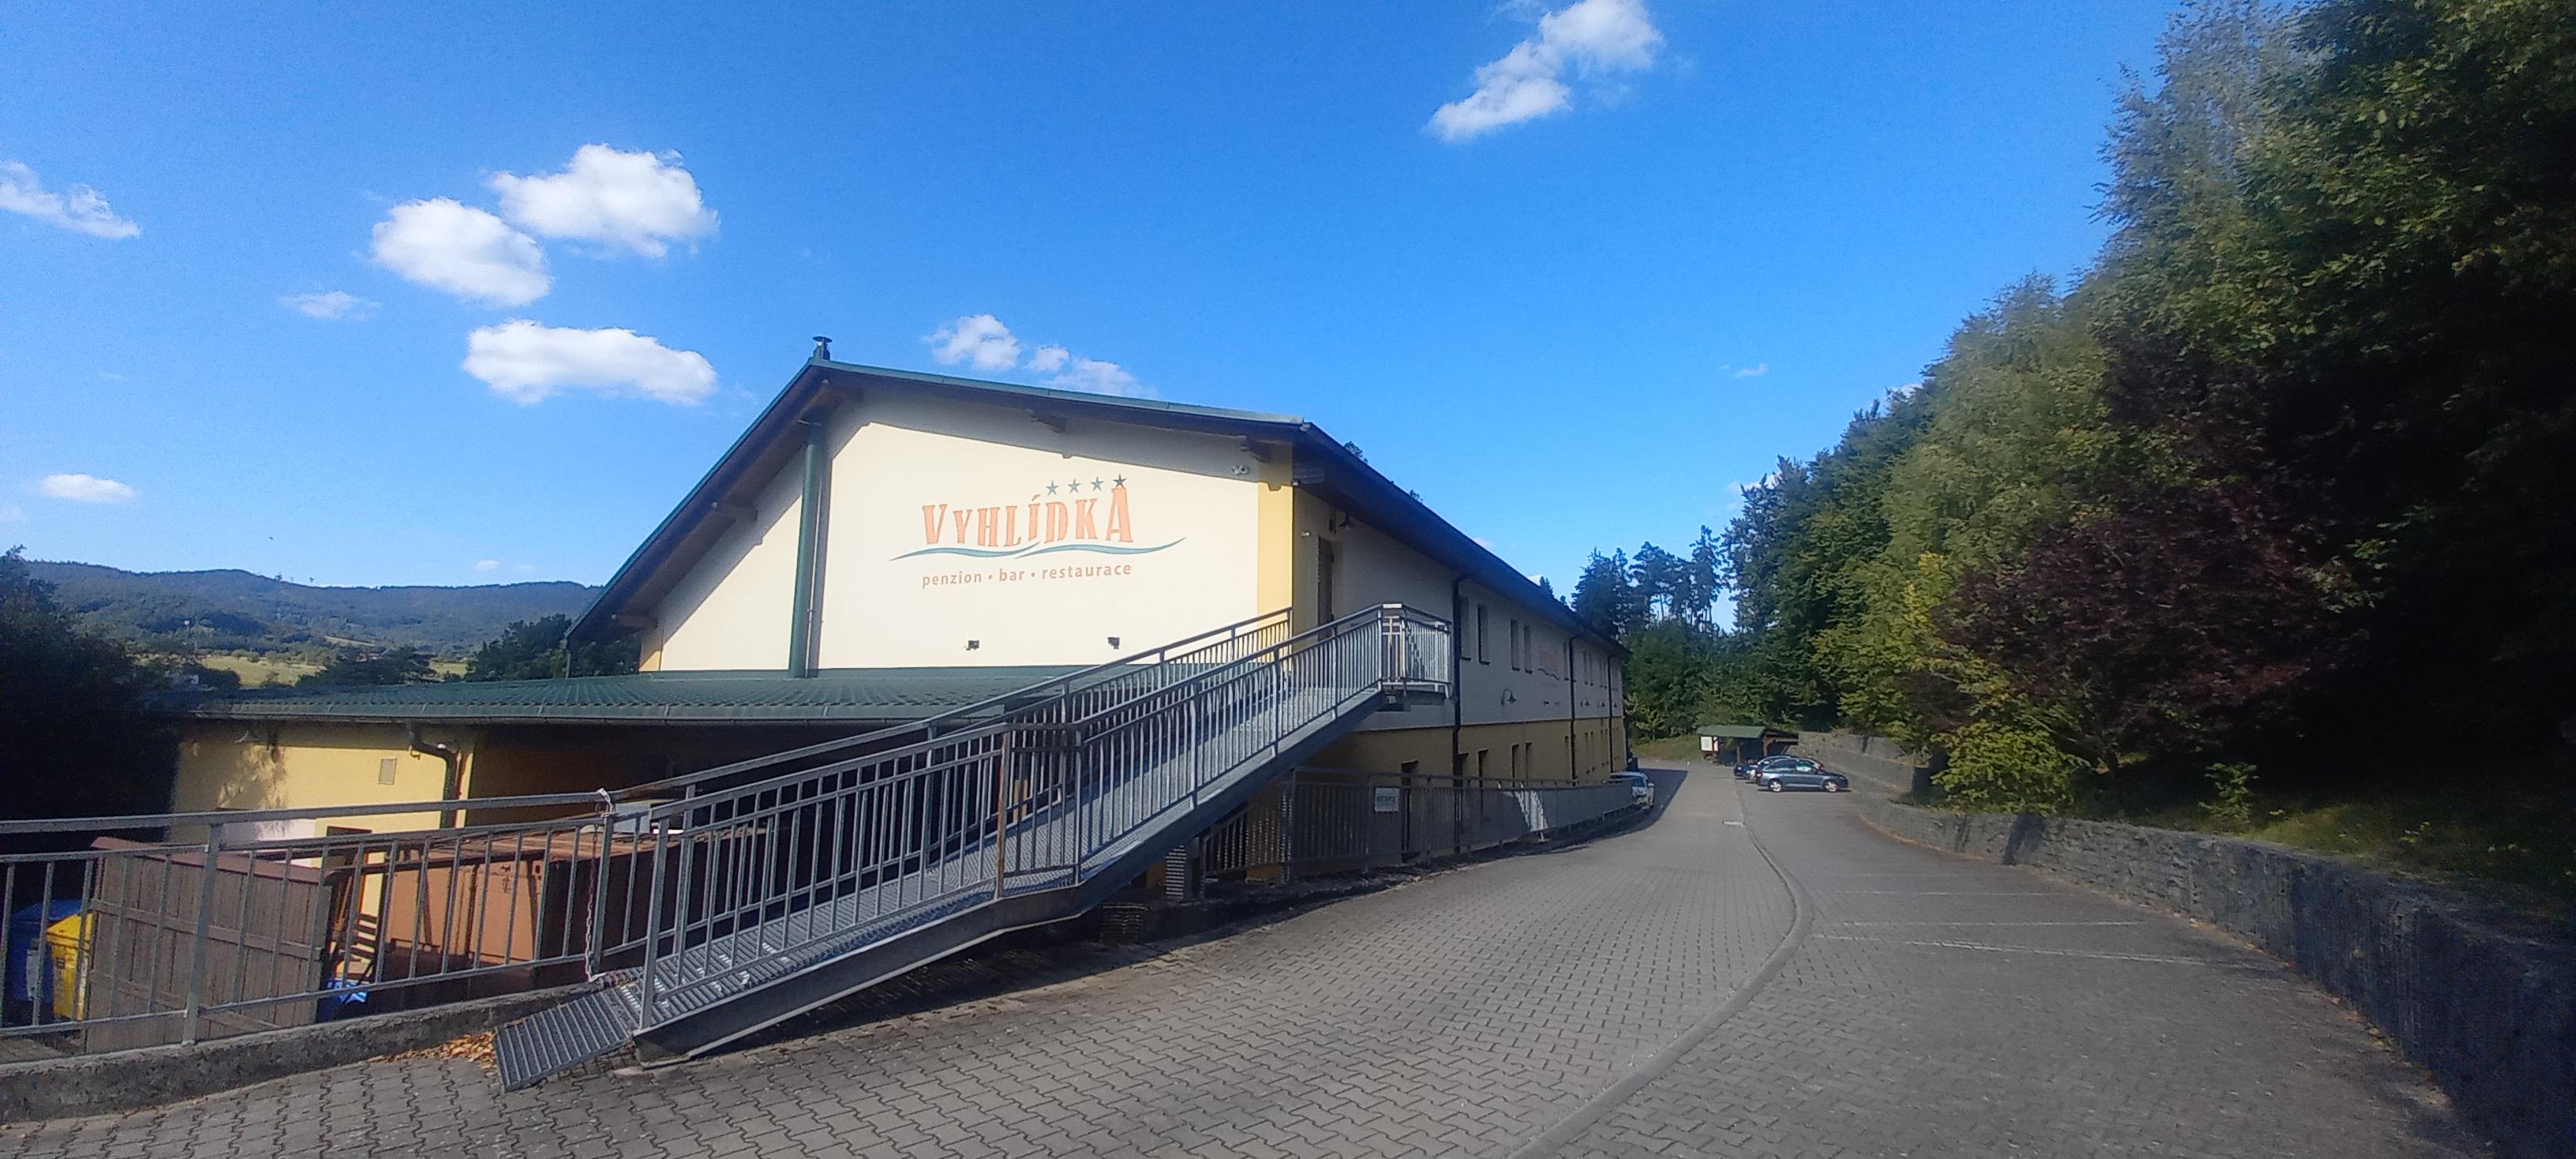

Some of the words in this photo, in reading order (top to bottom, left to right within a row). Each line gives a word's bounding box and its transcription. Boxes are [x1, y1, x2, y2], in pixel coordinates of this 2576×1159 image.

[922, 570, 982, 589] penzion
[998, 568, 1025, 582] bar
[1042, 564, 1133, 580] restaurace
